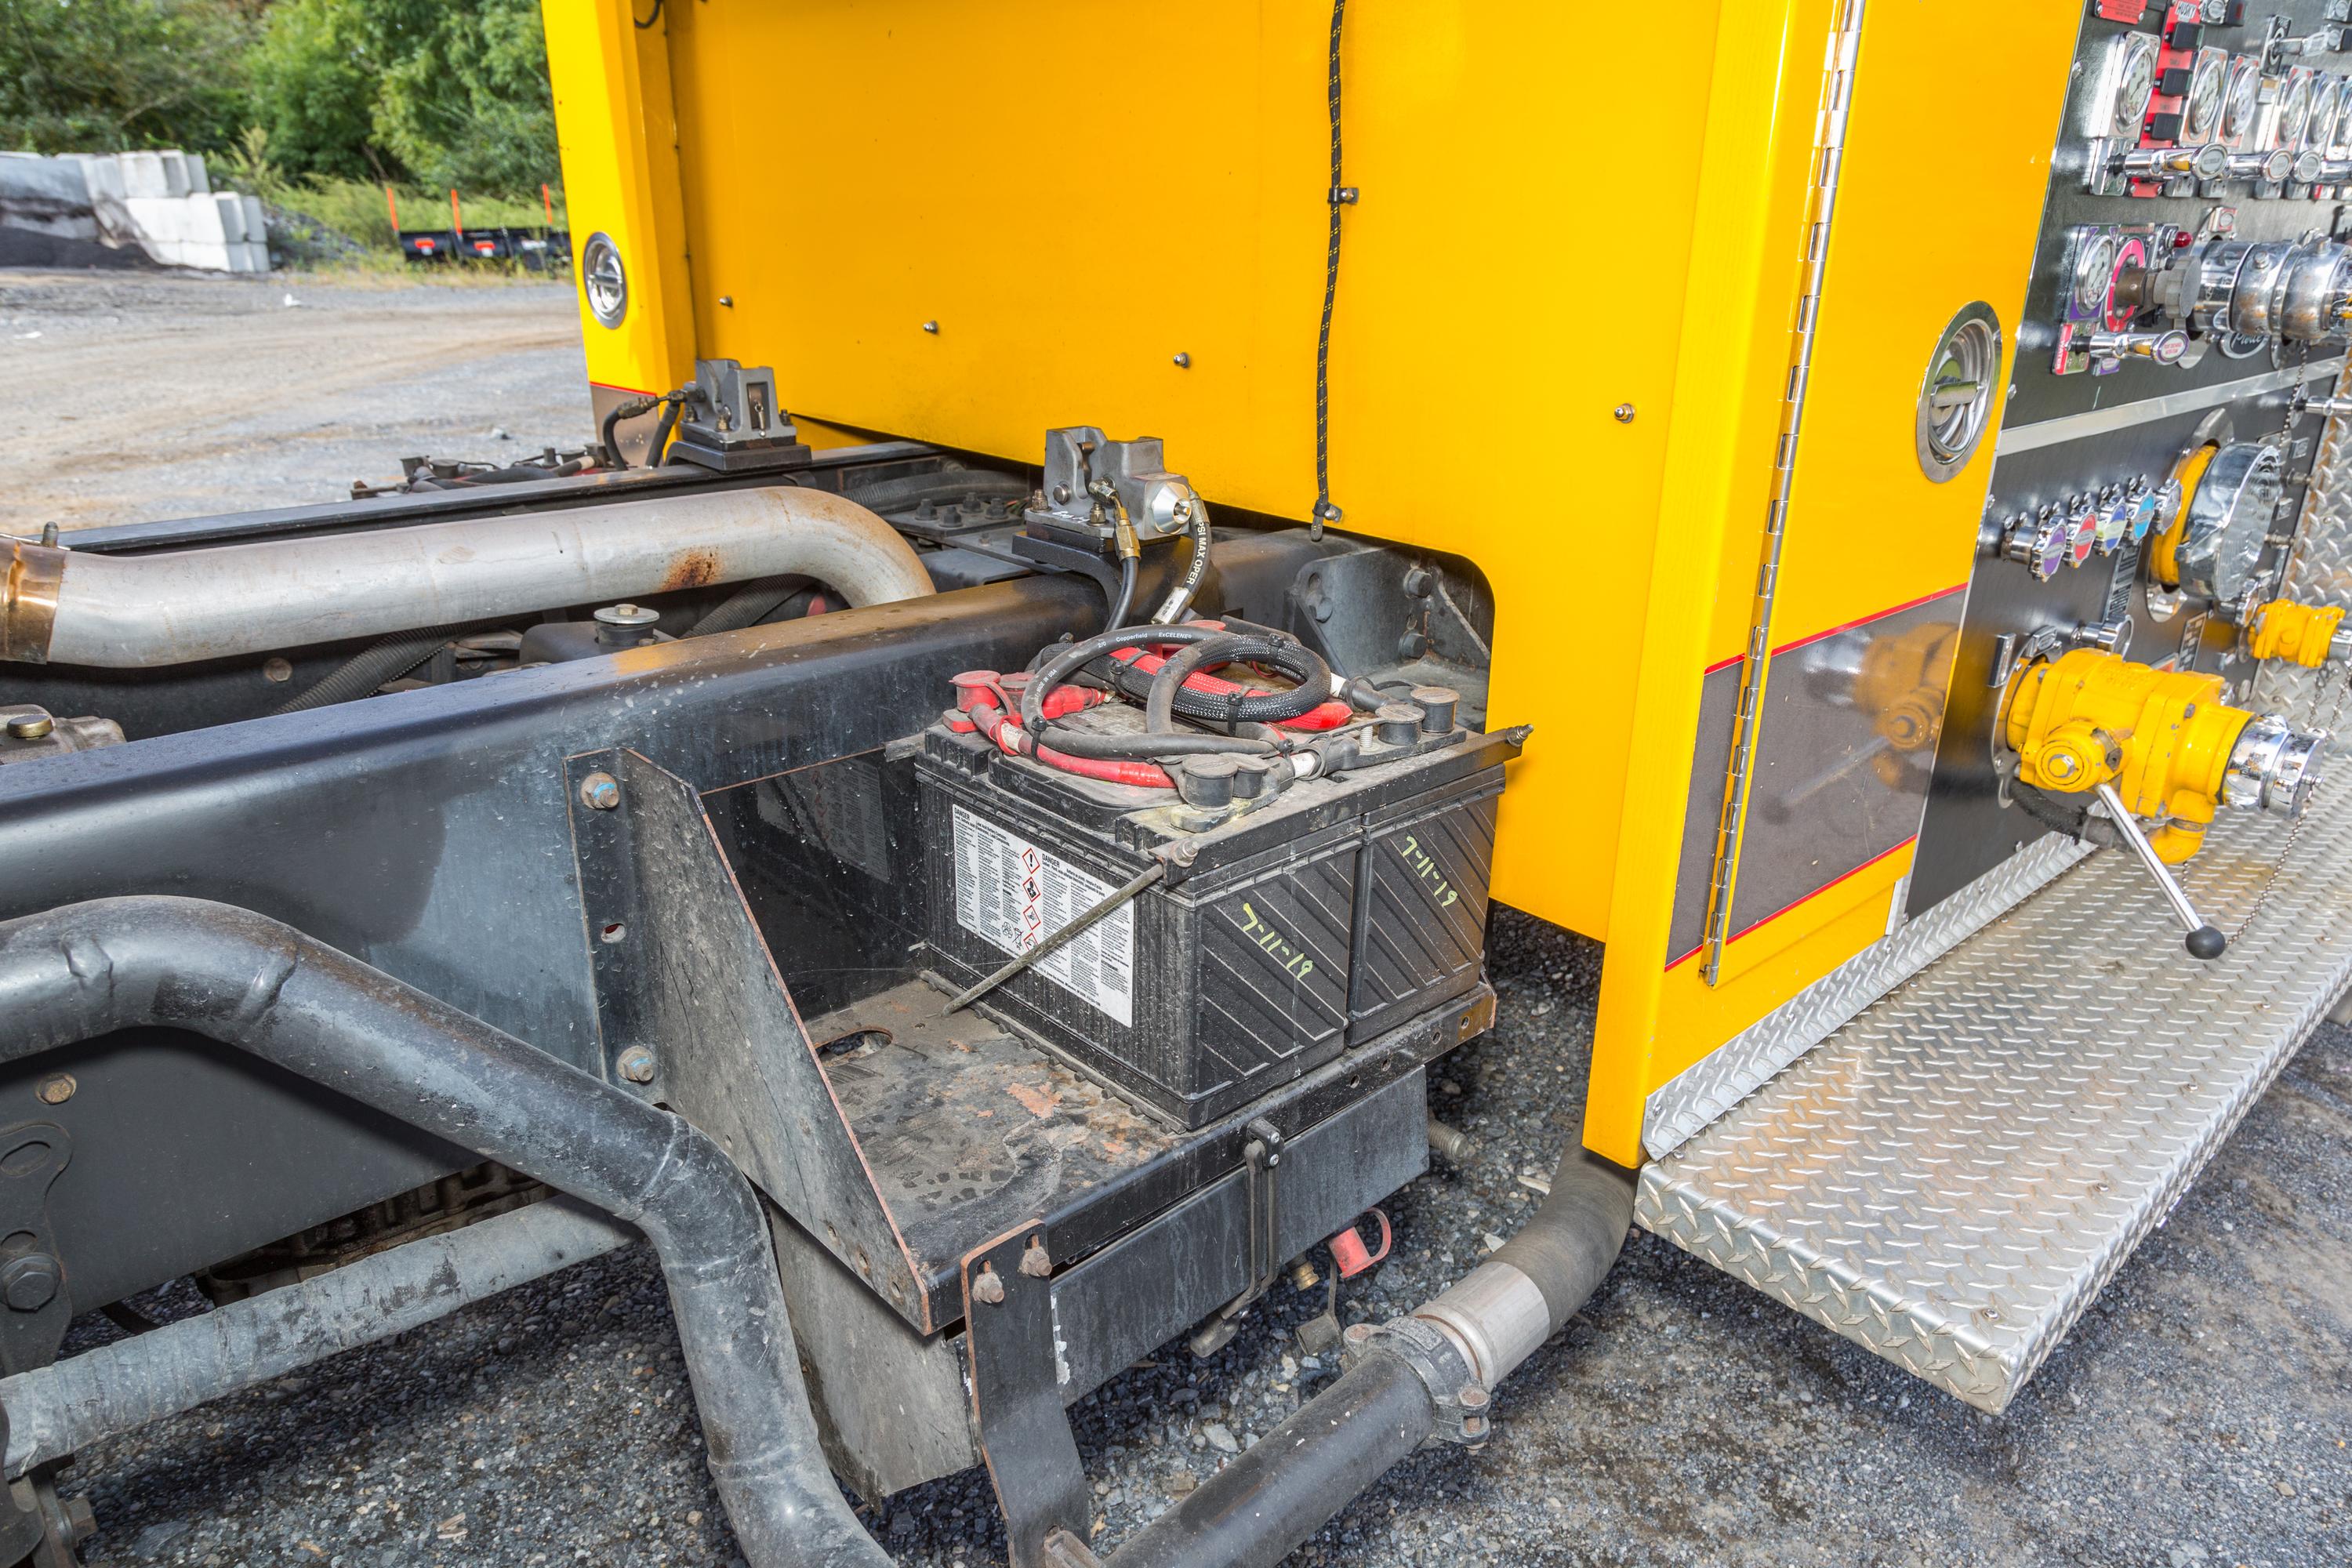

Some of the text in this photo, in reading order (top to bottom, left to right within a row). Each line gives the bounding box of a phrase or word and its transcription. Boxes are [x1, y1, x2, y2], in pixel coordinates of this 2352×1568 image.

[1197, 537, 1207, 558] MAX
[1186, 559, 1203, 585] OPER
[1116, 633, 1148, 642] Copperfield
[1048, 669, 1057, 677] USA
[954, 808, 971, 821] DANGER
[1042, 853, 1060, 868] DANGER
[1402, 836, 1458, 907] 7-11-19
[1243, 902, 1313, 980] 7-11-19
